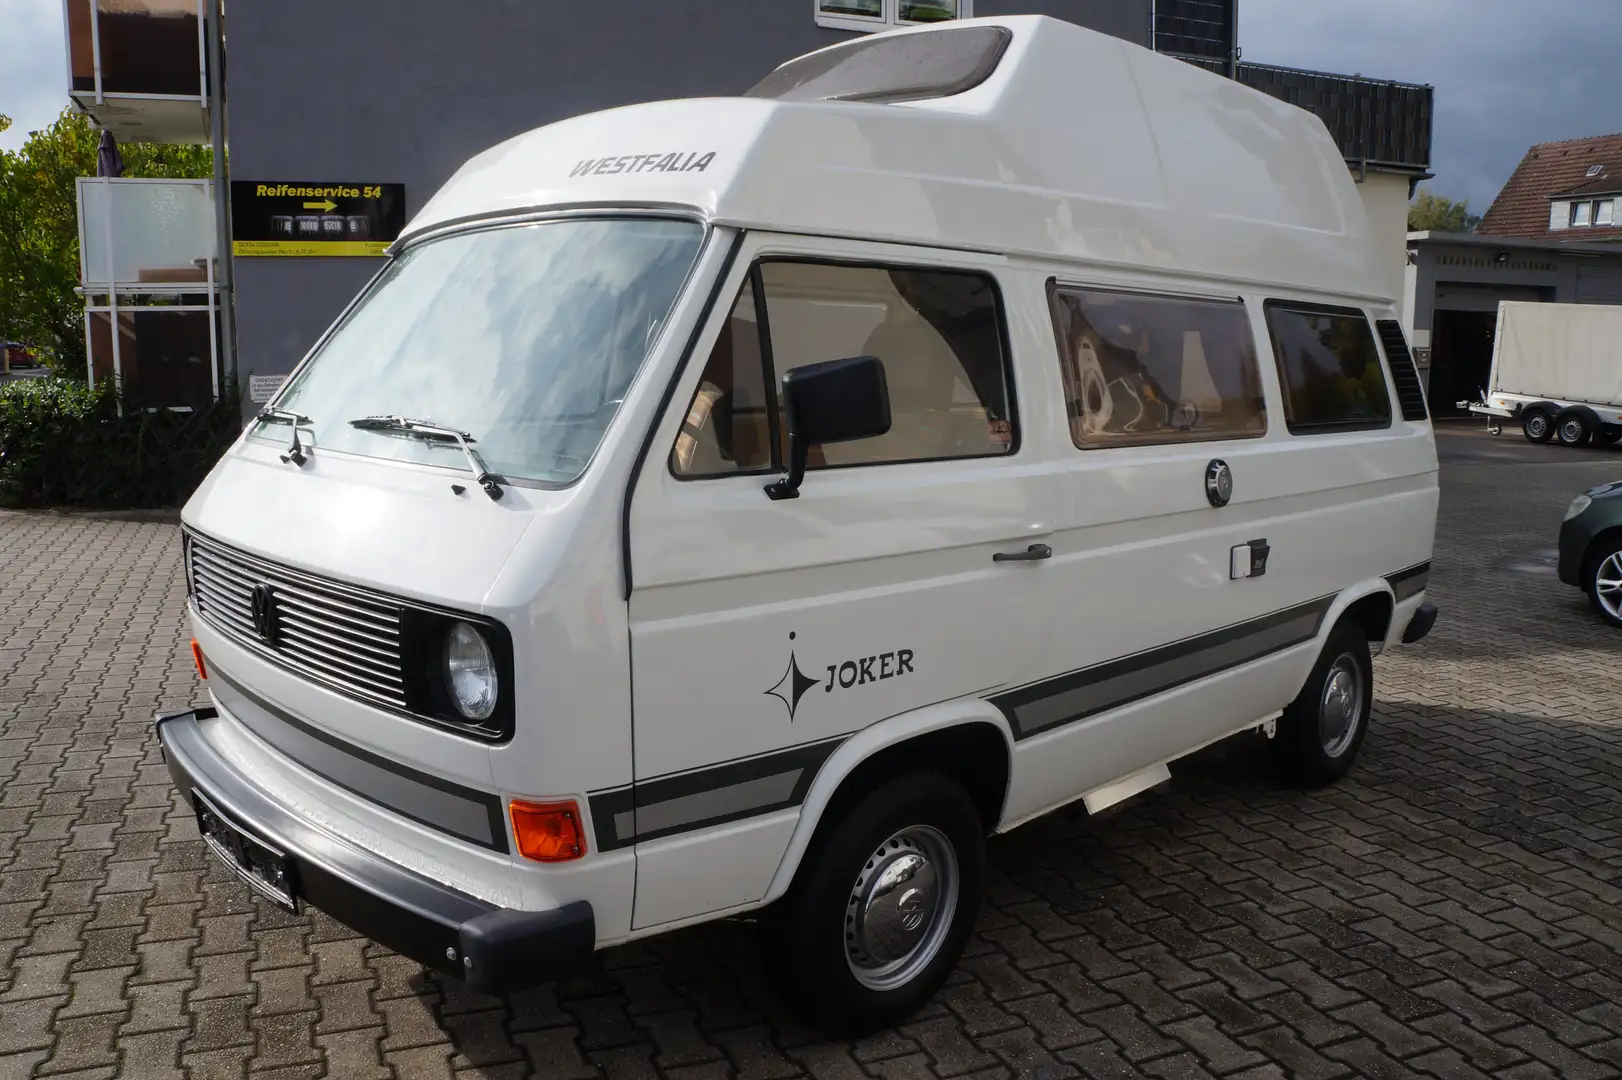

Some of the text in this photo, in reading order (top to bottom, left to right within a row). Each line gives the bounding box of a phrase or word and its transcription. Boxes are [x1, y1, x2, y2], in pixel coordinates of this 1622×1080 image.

[568, 151, 717, 178] WESTFALIA
[257, 185, 382, 198] Reifenservice 54
[824, 649, 915, 693] JOKER
